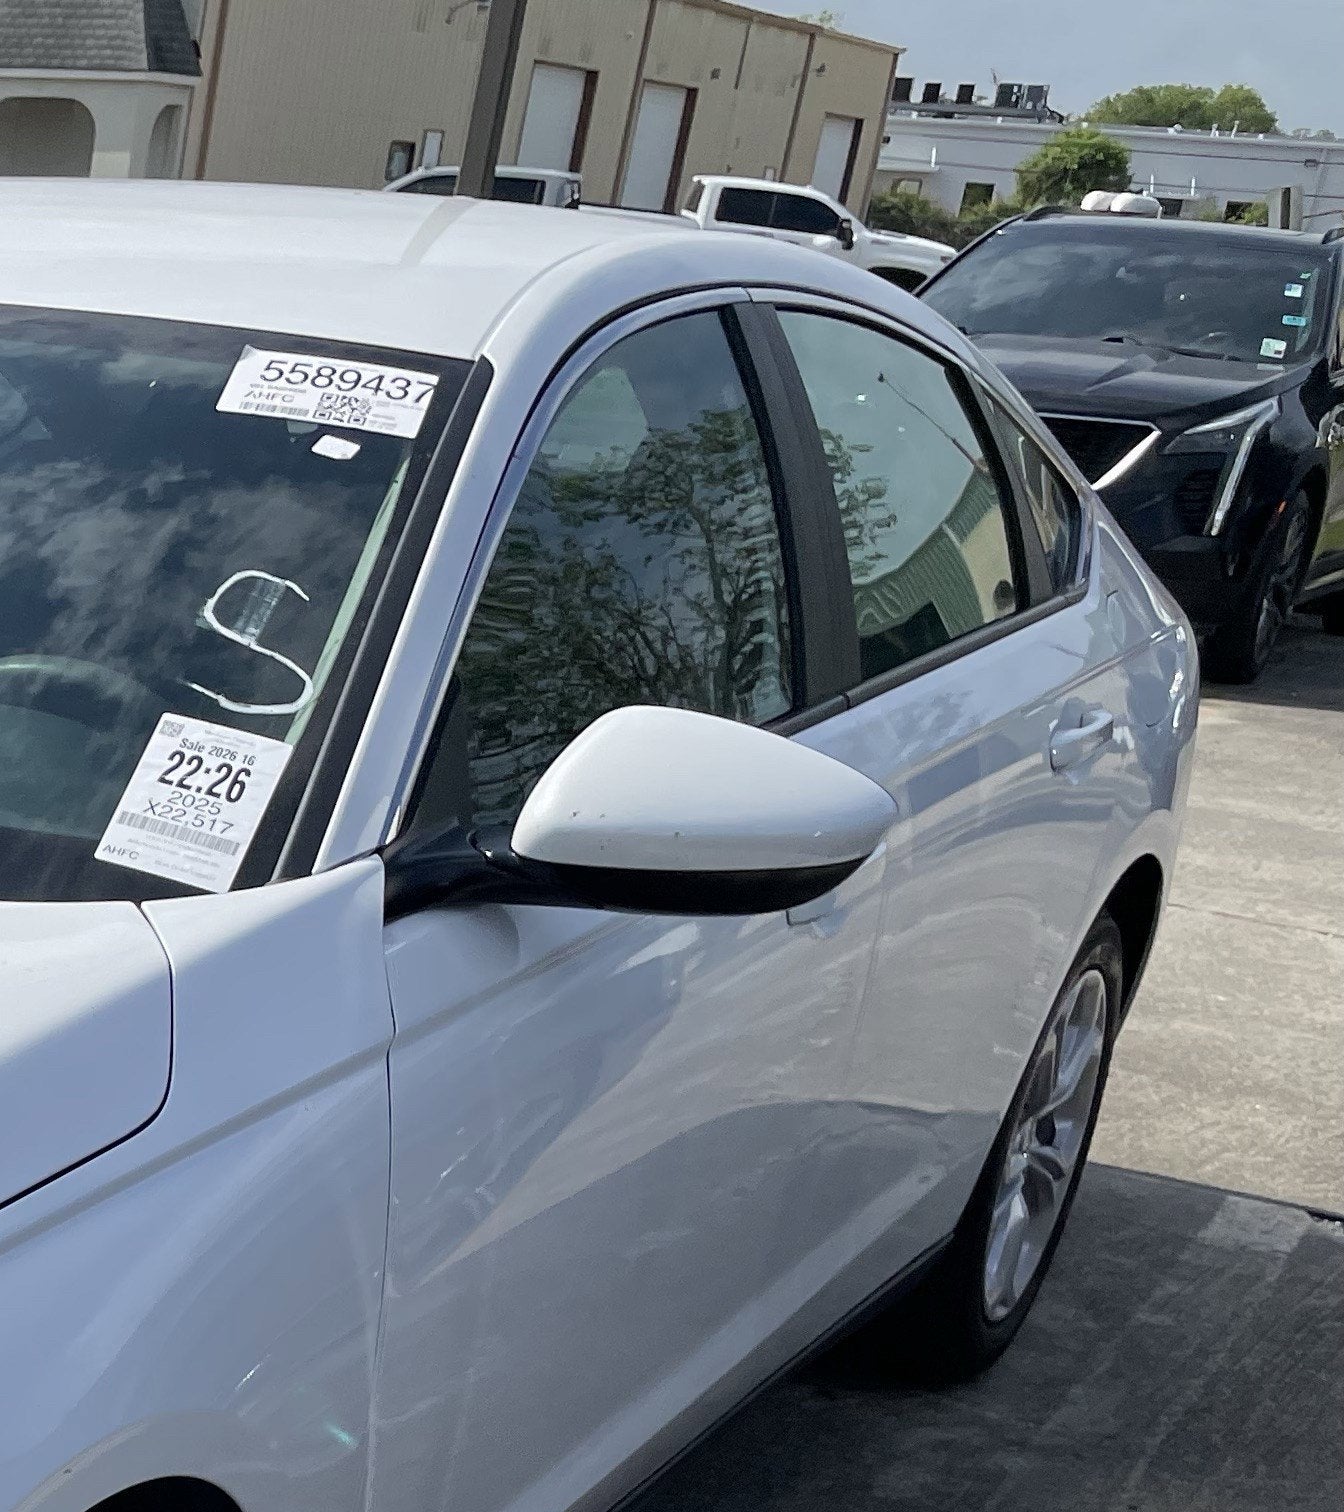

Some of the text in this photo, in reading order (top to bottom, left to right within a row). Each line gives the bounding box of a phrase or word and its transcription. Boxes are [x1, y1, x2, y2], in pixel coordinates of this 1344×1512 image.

[260, 360, 436, 404] 5589437
[179, 738, 205, 753] Sale
[157, 750, 251, 803] 22:26
[167, 791, 222, 815] 2025
